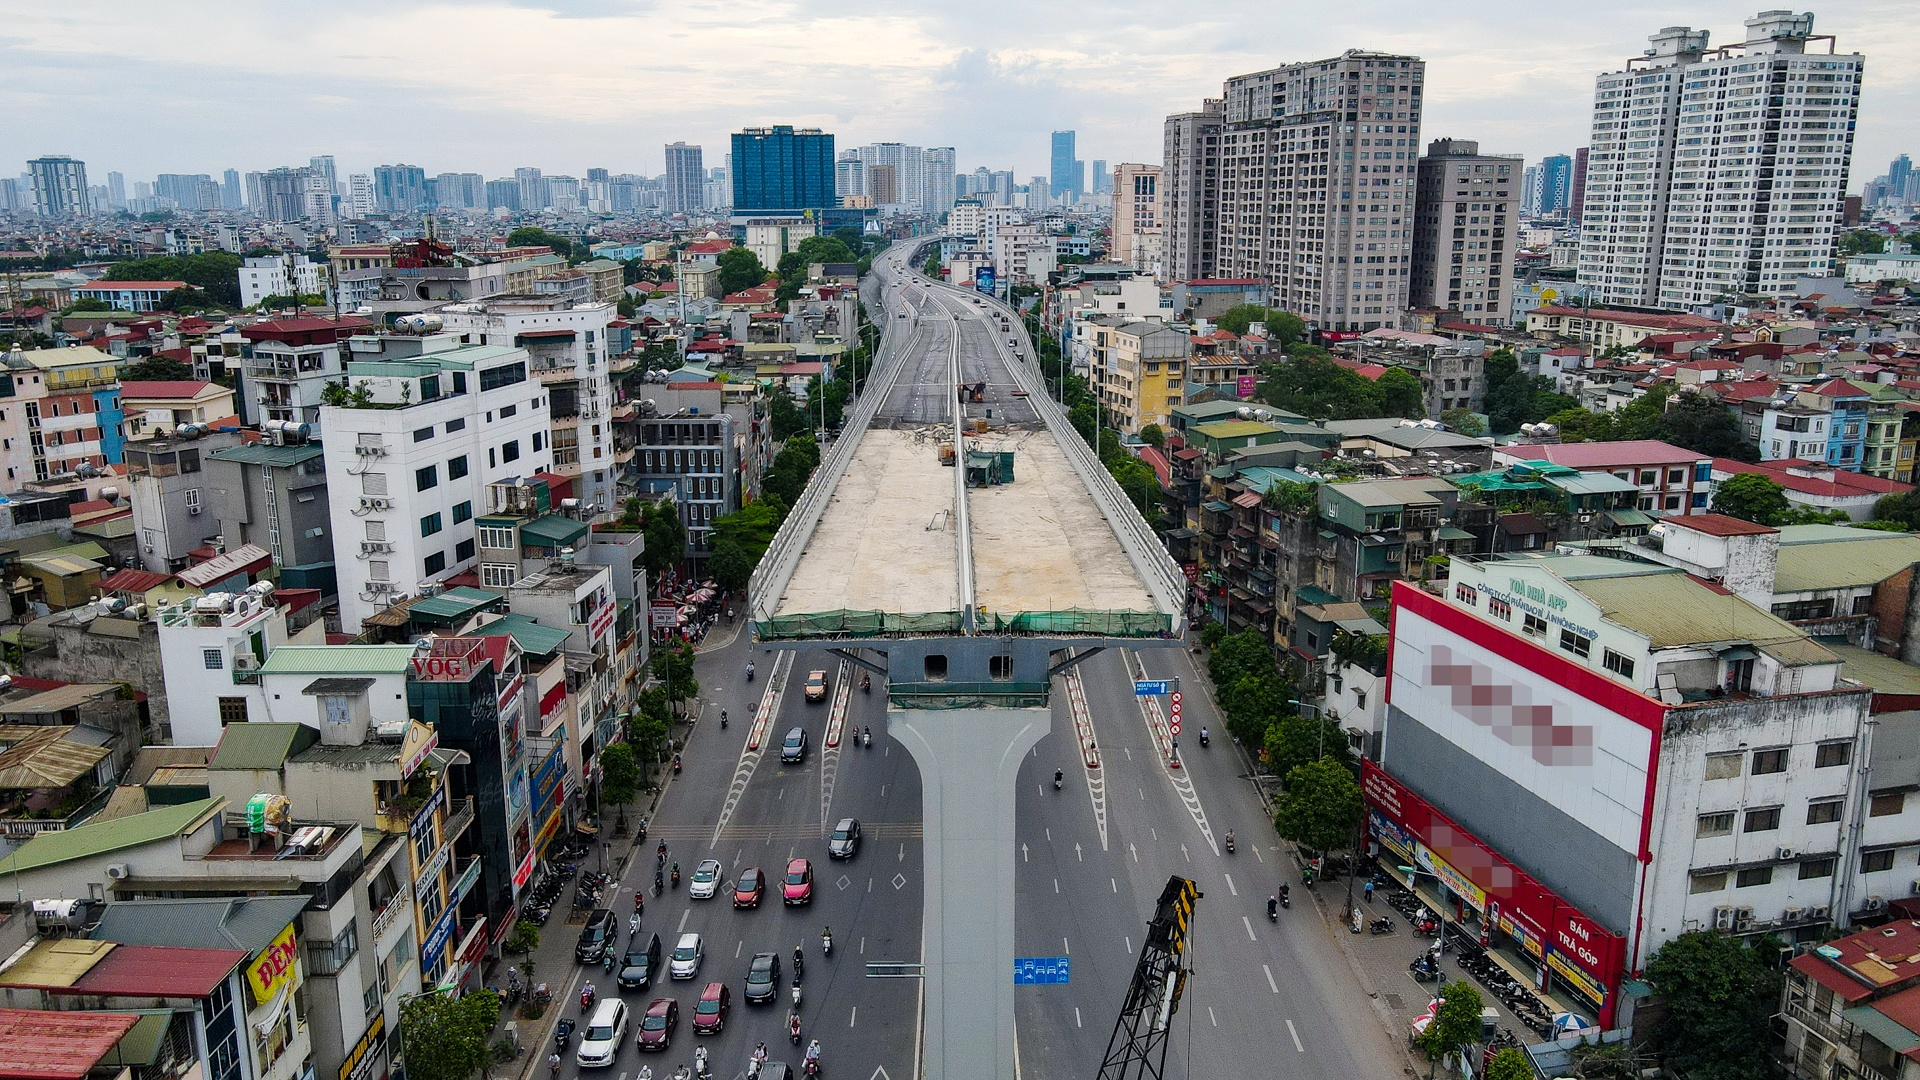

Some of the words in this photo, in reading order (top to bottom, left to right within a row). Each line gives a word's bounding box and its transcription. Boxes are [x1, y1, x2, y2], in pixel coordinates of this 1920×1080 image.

[1477, 583, 1494, 596] CÔNG
[1494, 591, 1501, 600] TY
[1501, 591, 1511, 603] CỔ
[1576, 625, 1599, 641] NGHIỆP
[1509, 578, 1525, 596] TOÀ
[1527, 585, 1546, 605] NHÀ
[1547, 594, 1567, 612] APP
[411, 658, 461, 676] VOG
[1569, 920, 1589, 942] BÁN
[256, 934, 297, 990] ĐỆM
[1558, 931, 1576, 953] TRẢ
[1578, 949, 1598, 966] GÓP
